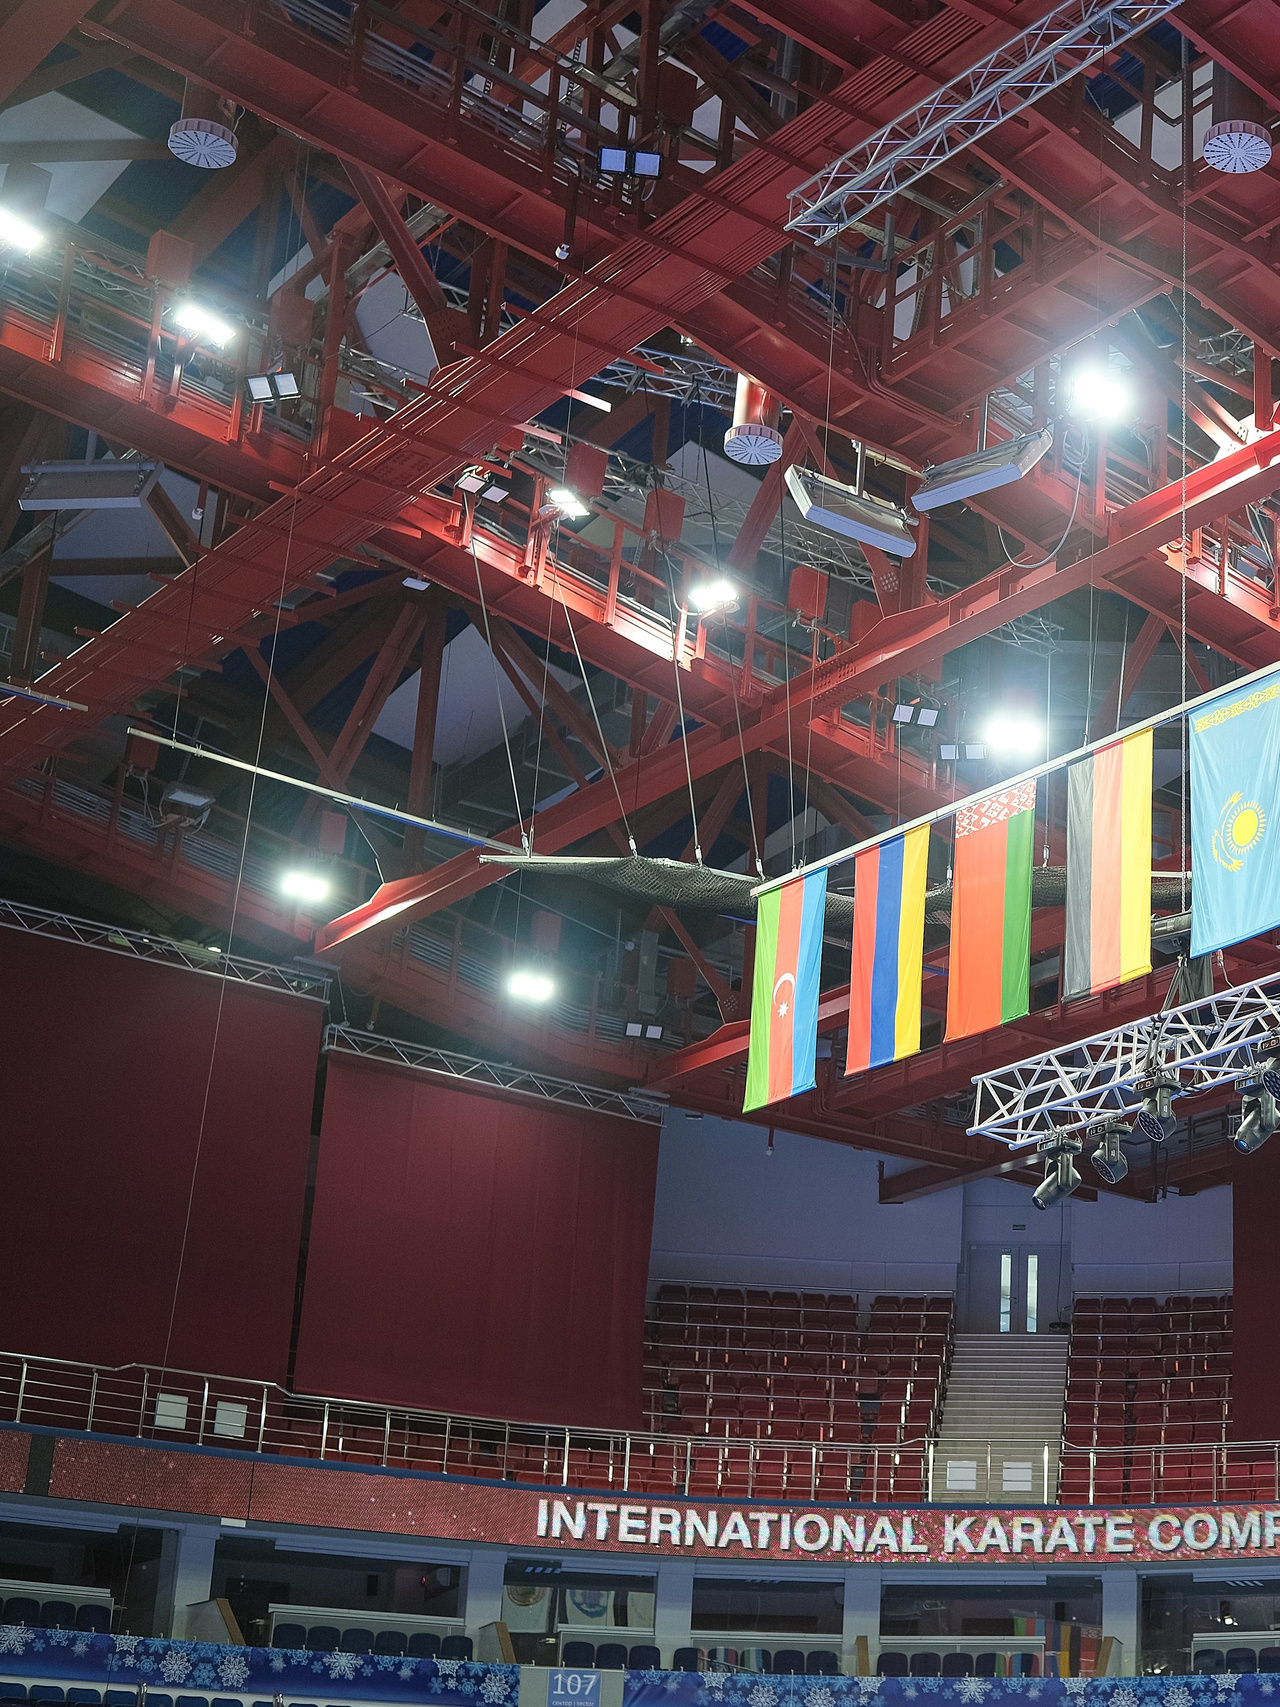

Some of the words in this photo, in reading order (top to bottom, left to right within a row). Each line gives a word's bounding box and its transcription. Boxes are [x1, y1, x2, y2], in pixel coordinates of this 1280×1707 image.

[537, 1498, 928, 1554] INTERNATIONAL
[943, 1514, 1135, 1555] KARATE
[553, 1673, 597, 1695] 107
